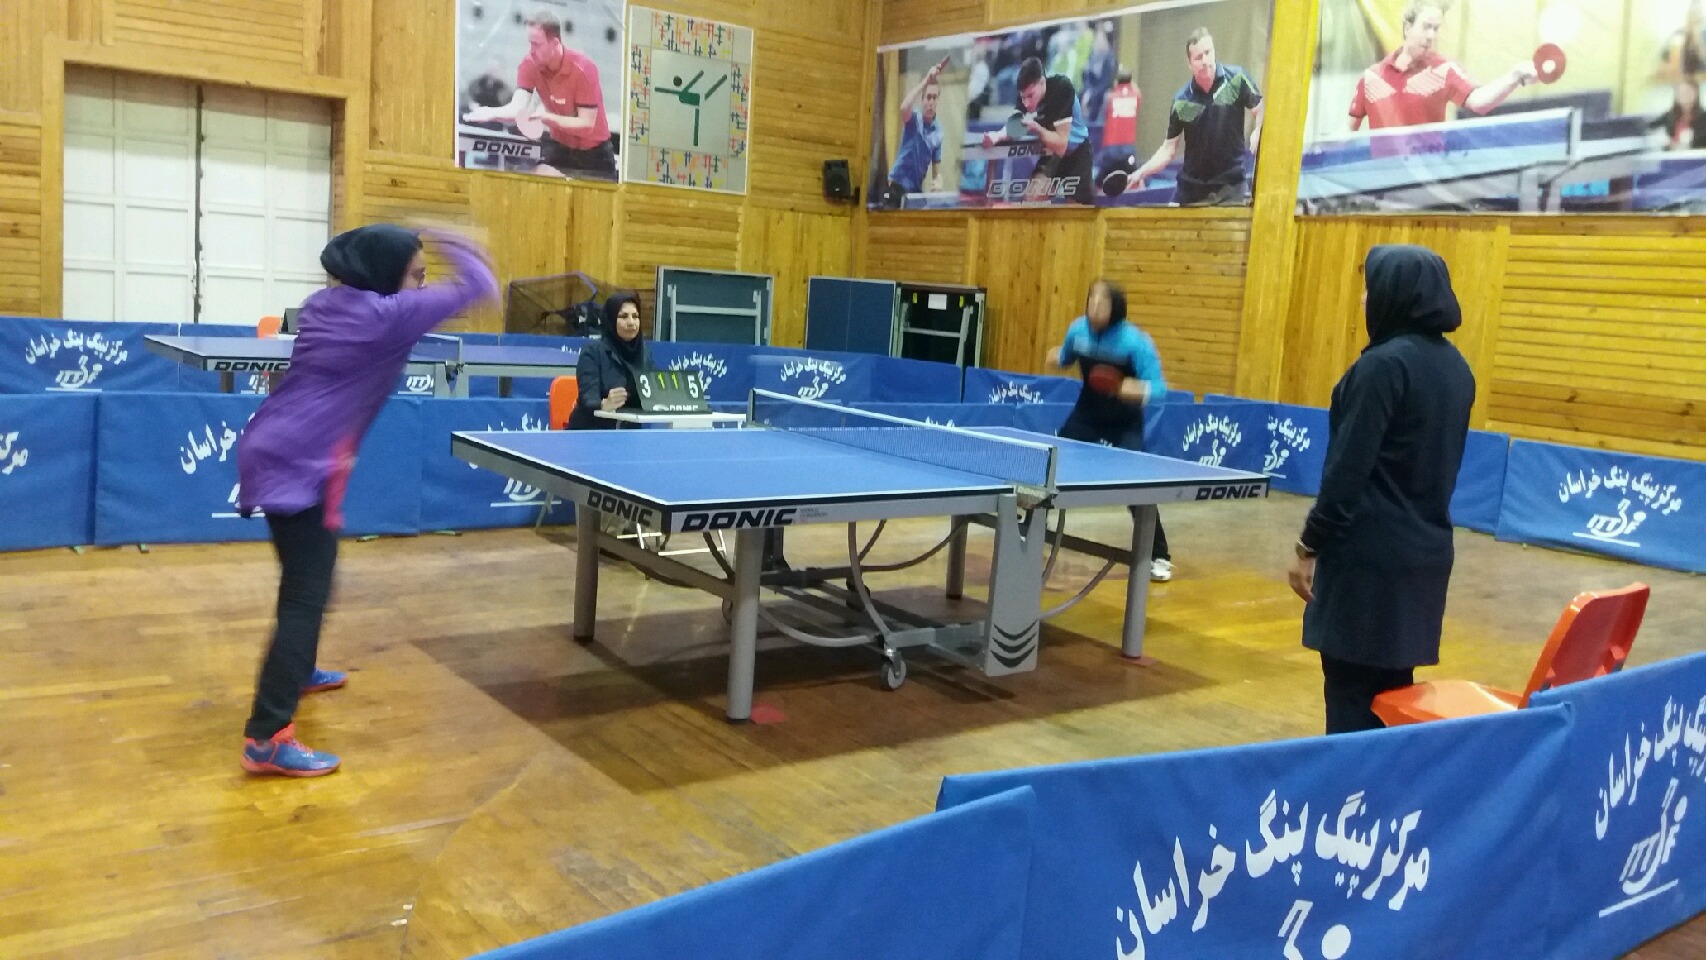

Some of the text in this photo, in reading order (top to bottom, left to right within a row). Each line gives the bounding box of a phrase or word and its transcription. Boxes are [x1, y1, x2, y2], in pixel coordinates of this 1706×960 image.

[472, 141, 532, 156] DONIC
[986, 176, 1081, 198] DONIC
[214, 361, 289, 371] DONIC
[640, 374, 651, 398] 3
[687, 374, 699, 398] 5
[180, 420, 237, 474] خراسان
[1196, 485, 1262, 500] DONIC
[1558, 468, 1601, 503] خراسان
[1603, 465, 1630, 494] پنگ
[587, 489, 653, 526] DONIC
[1651, 485, 1682, 515] مرکز
[680, 508, 797, 533] DONIC
[1654, 694, 1684, 768] پنگ
[1595, 721, 1652, 841] خراسان
[1245, 788, 1309, 887] پنگ
[1315, 790, 1381, 899] پینگ
[1362, 809, 1430, 911] مرکز
[1116, 823, 1236, 960] خراسان
